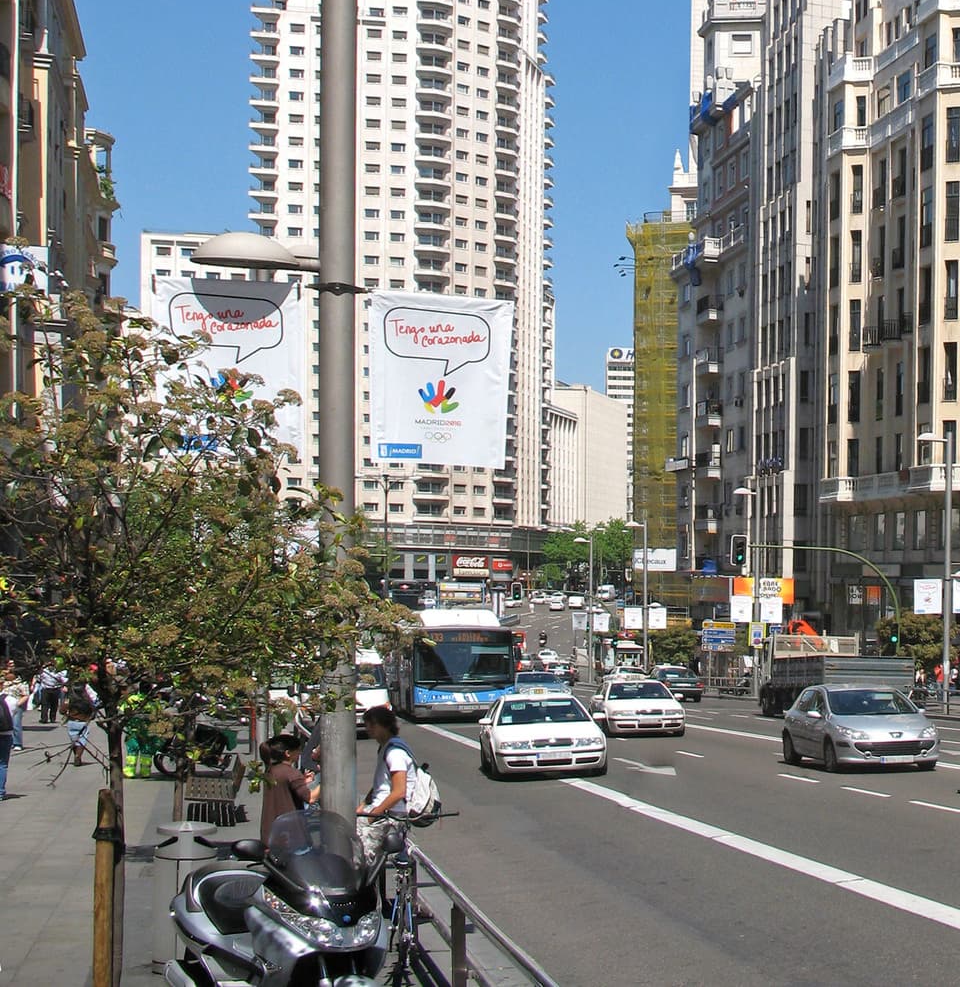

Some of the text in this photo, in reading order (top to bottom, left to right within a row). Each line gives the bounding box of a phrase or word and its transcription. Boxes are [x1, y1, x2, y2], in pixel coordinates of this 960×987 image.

[175, 304, 244, 331] Tengo una
[389, 318, 455, 345] Tengo una
